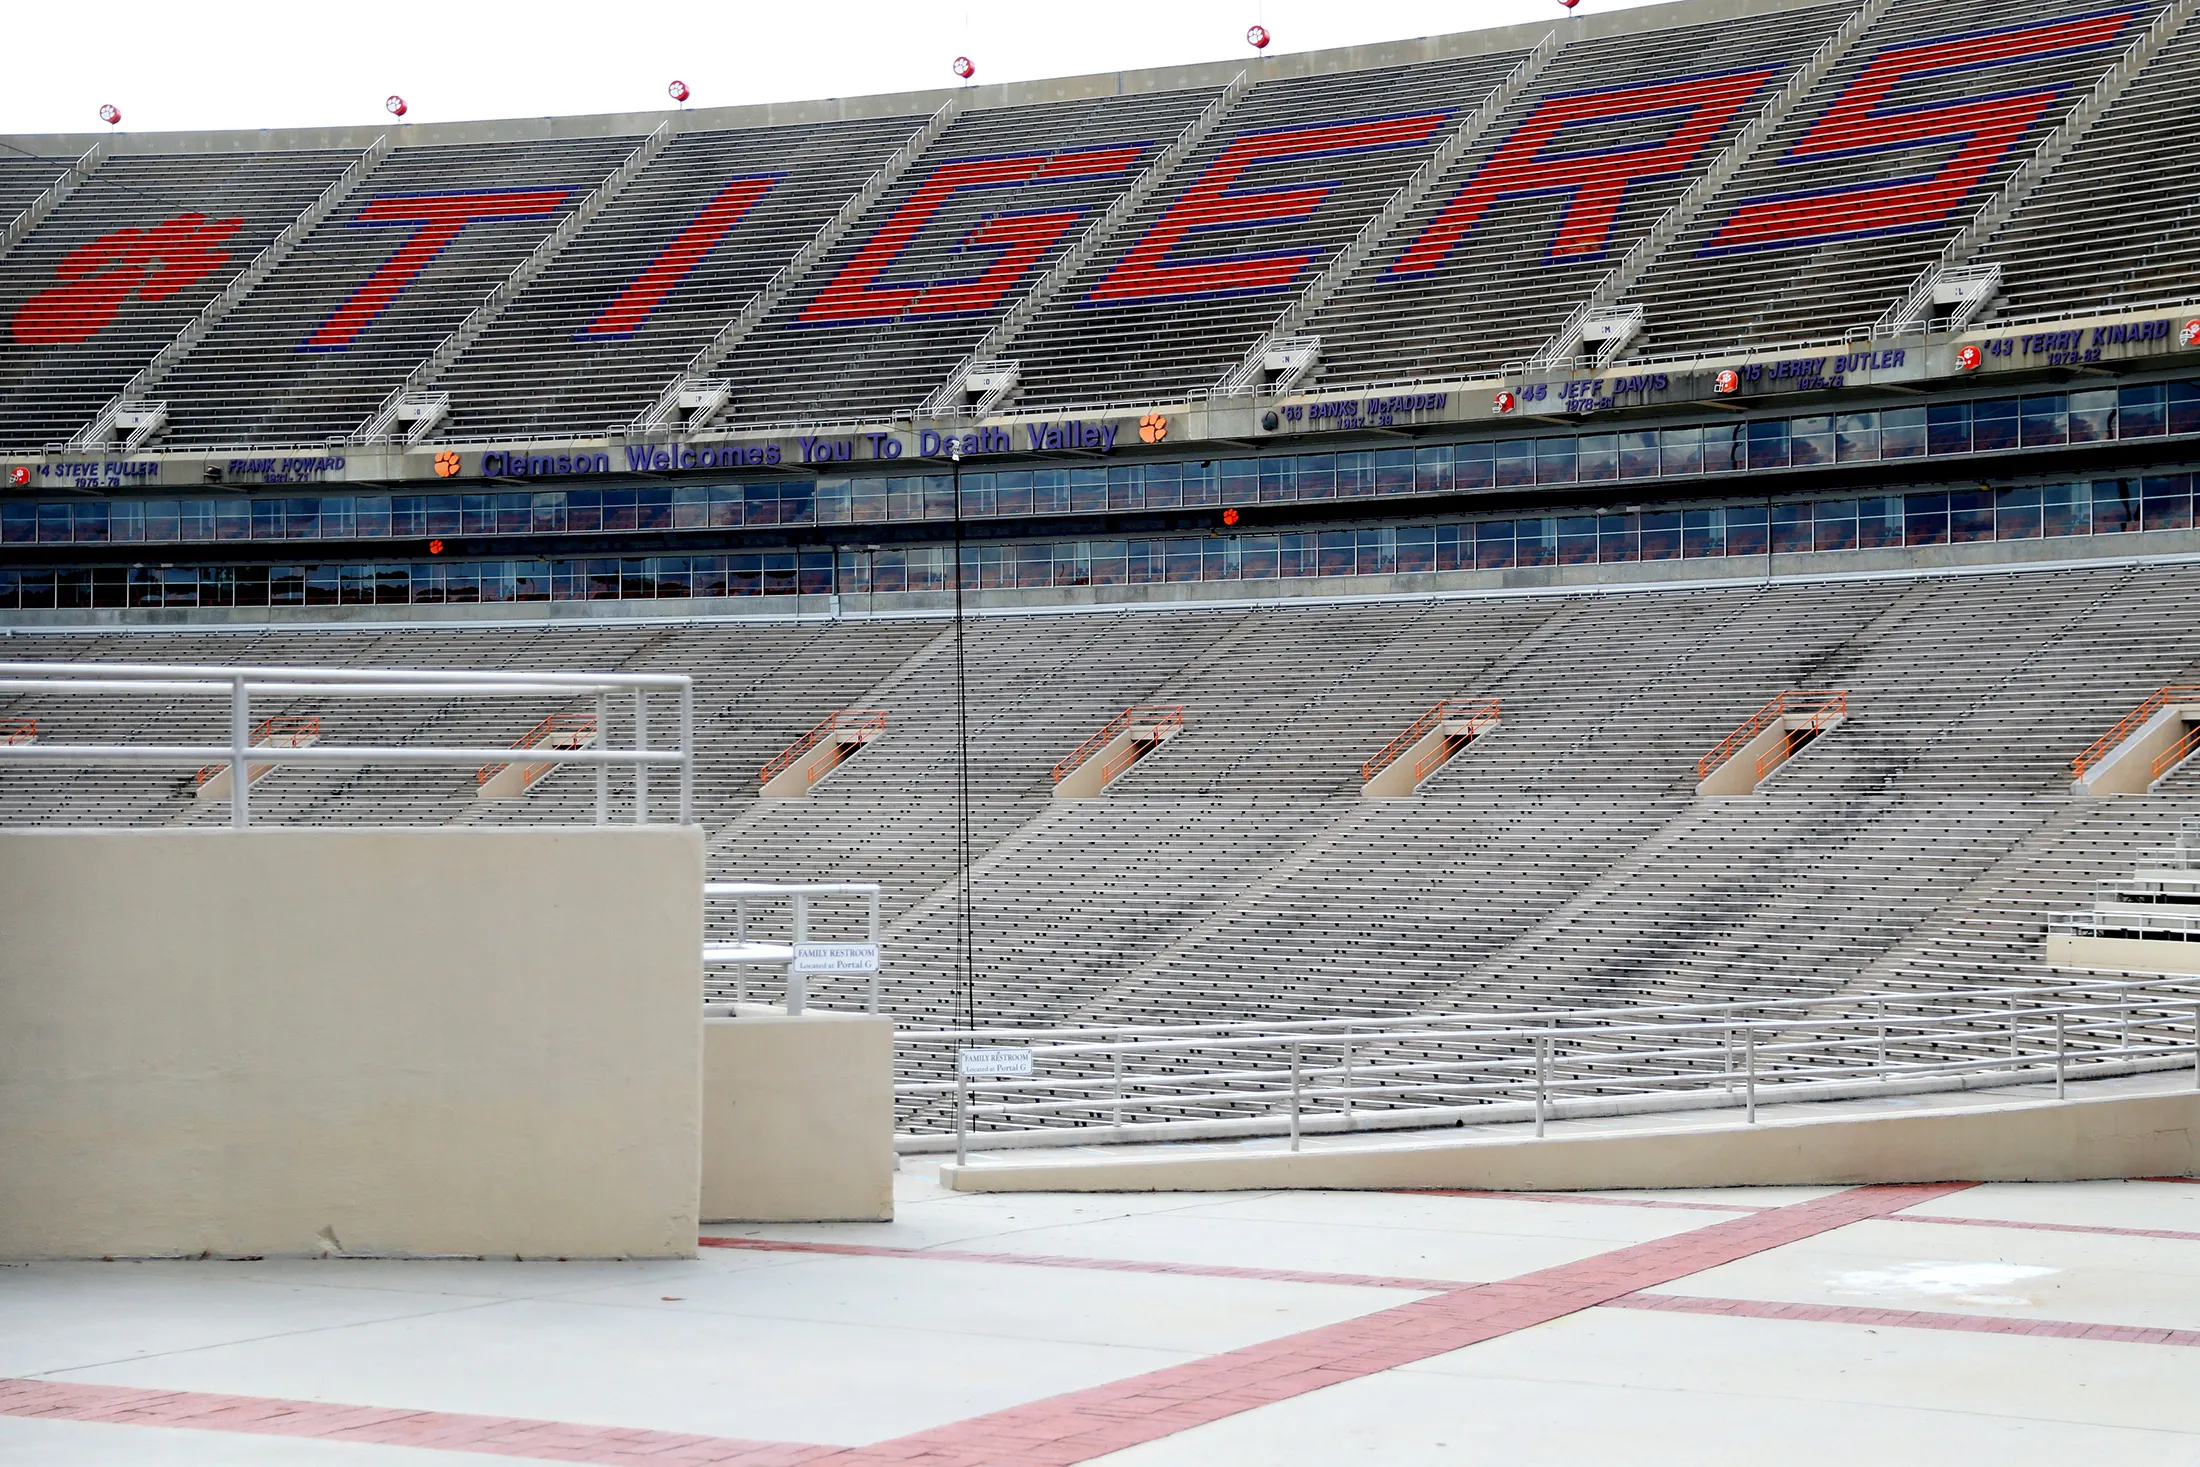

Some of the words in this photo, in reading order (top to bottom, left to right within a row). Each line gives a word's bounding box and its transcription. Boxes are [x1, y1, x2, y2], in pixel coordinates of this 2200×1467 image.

[294, 3, 2150, 356] TIGERS
[2021, 330, 2083, 354] TERRY
[2092, 319, 2169, 346] KINARD
[1769, 356, 1825, 379] JERRY
[1834, 349, 1905, 373] BUTLER
[1558, 378, 1604, 399] JEFF
[1614, 372, 1668, 394] DAVIS
[1308, 399, 1358, 420] BANKS
[1367, 393, 1447, 415] McFADDEN
[480, 450, 609, 477] Clemson
[625, 442, 781, 472] Welcomes
[800, 435, 851, 463] You
[867, 431, 902, 459] To
[919, 425, 1010, 458] Death
[1026, 419, 1119, 451] Valley
[54, 462, 99, 478] STEVE
[104, 461, 159, 477] FULLER
[227, 458, 277, 473] FRANK
[281, 456, 346, 473] HOWARD
[798, 949, 828, 957] FAMILY
[829, 948, 875, 957] RESTROOM
[799, 960, 827, 969] Located
[837, 960, 862, 968] Portal
[864, 960, 872, 968] G
[965, 1054, 989, 1062] FAMILY
[997, 1064, 1018, 1072] Portal
[1020, 1063, 1026, 1071] G
